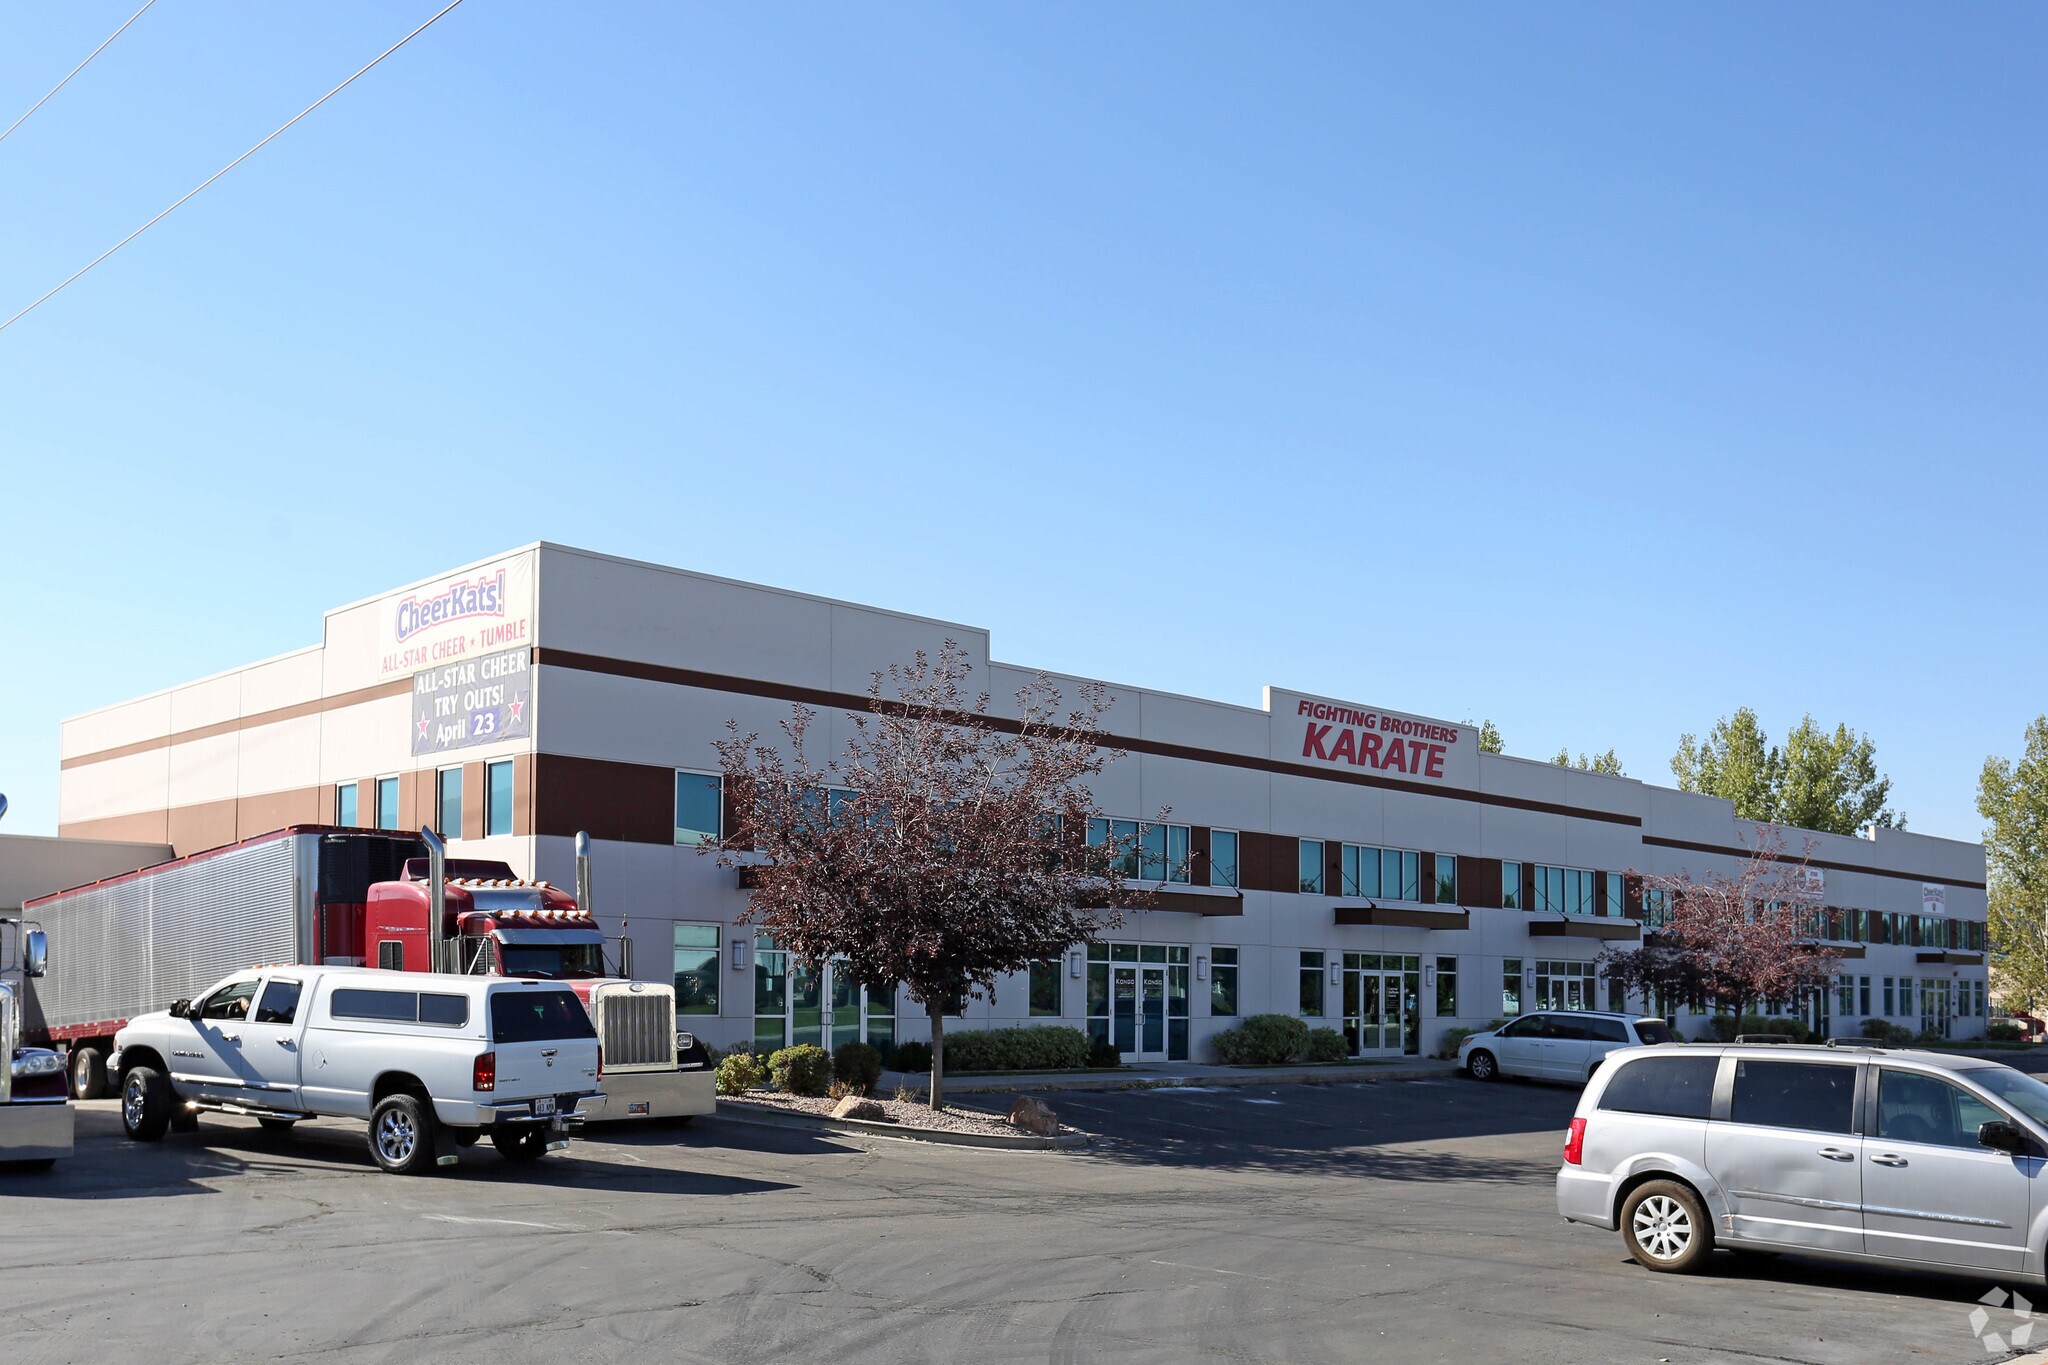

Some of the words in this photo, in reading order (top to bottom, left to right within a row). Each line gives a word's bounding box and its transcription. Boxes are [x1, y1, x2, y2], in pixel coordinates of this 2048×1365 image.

[397, 573, 503, 639] CheerKats!
[381, 646, 428, 674] ALL-STAR
[431, 636, 466, 660] CHEER
[480, 619, 526, 648] TUMBLE
[415, 663, 477, 696] ALL-STAR
[481, 651, 527, 680] CHEER
[434, 694, 459, 718] TRY
[464, 684, 504, 712] OUTS!
[1297, 700, 1377, 729] FIGHTING
[1380, 716, 1459, 743] BROTHERS
[435, 718, 466, 748] April
[473, 712, 495, 736] 23
[1302, 722, 1447, 778] KARATE
